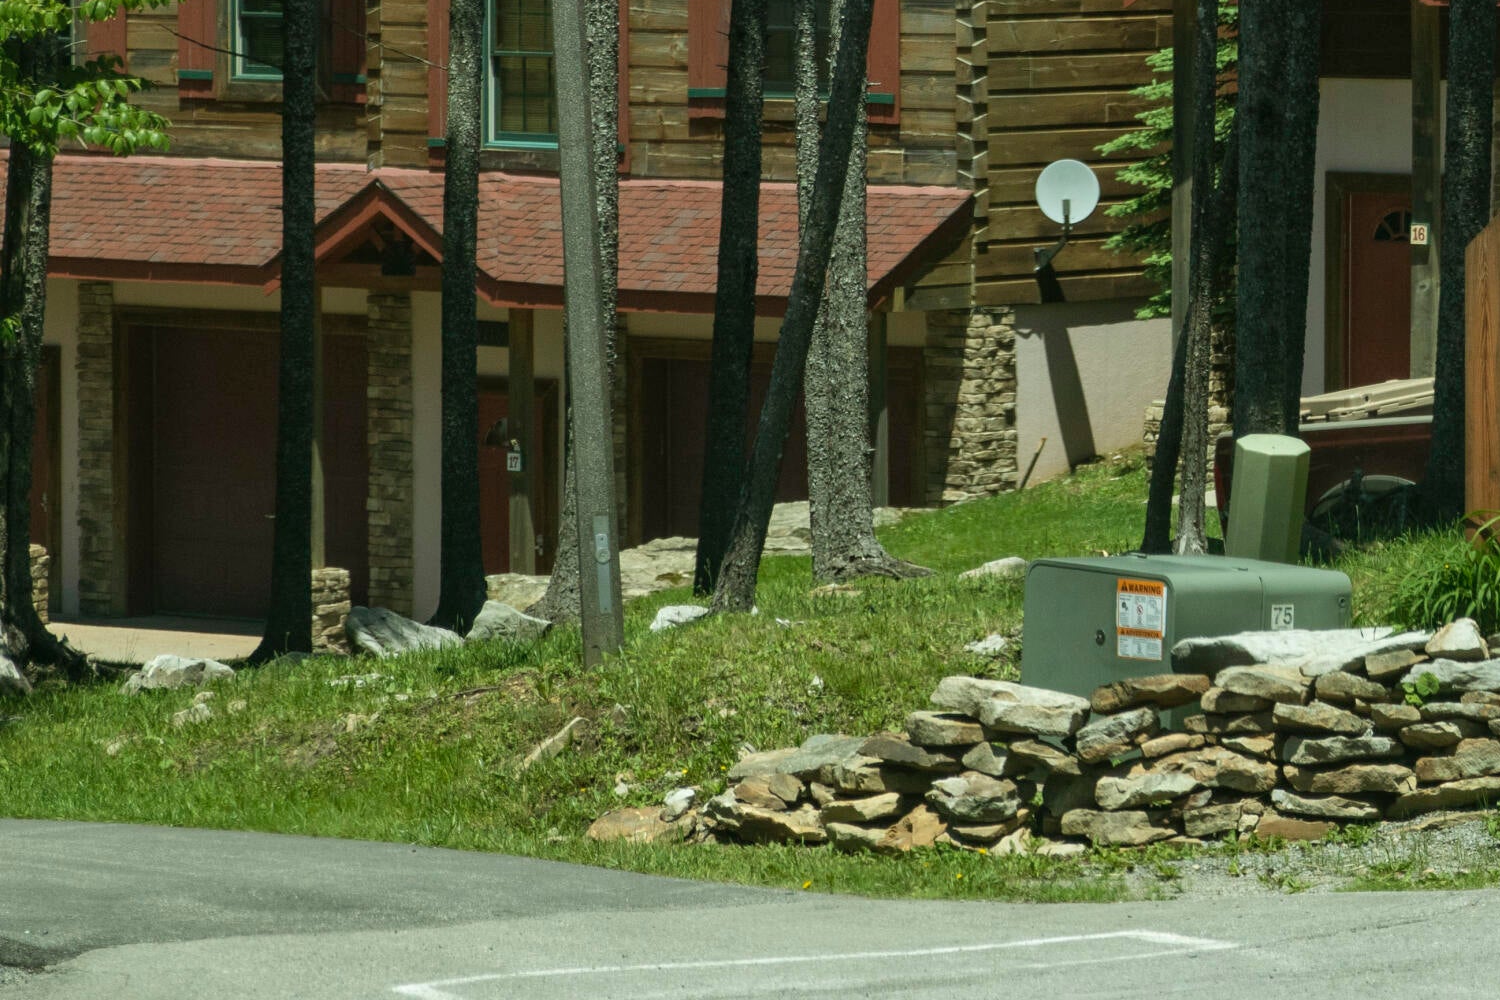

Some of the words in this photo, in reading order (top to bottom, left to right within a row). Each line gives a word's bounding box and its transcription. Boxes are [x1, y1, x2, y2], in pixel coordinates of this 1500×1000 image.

[1412, 226, 1425, 241] 16
[509, 456, 519, 469] 17
[1128, 583, 1162, 595] WARNING
[1273, 607, 1293, 625] 75
